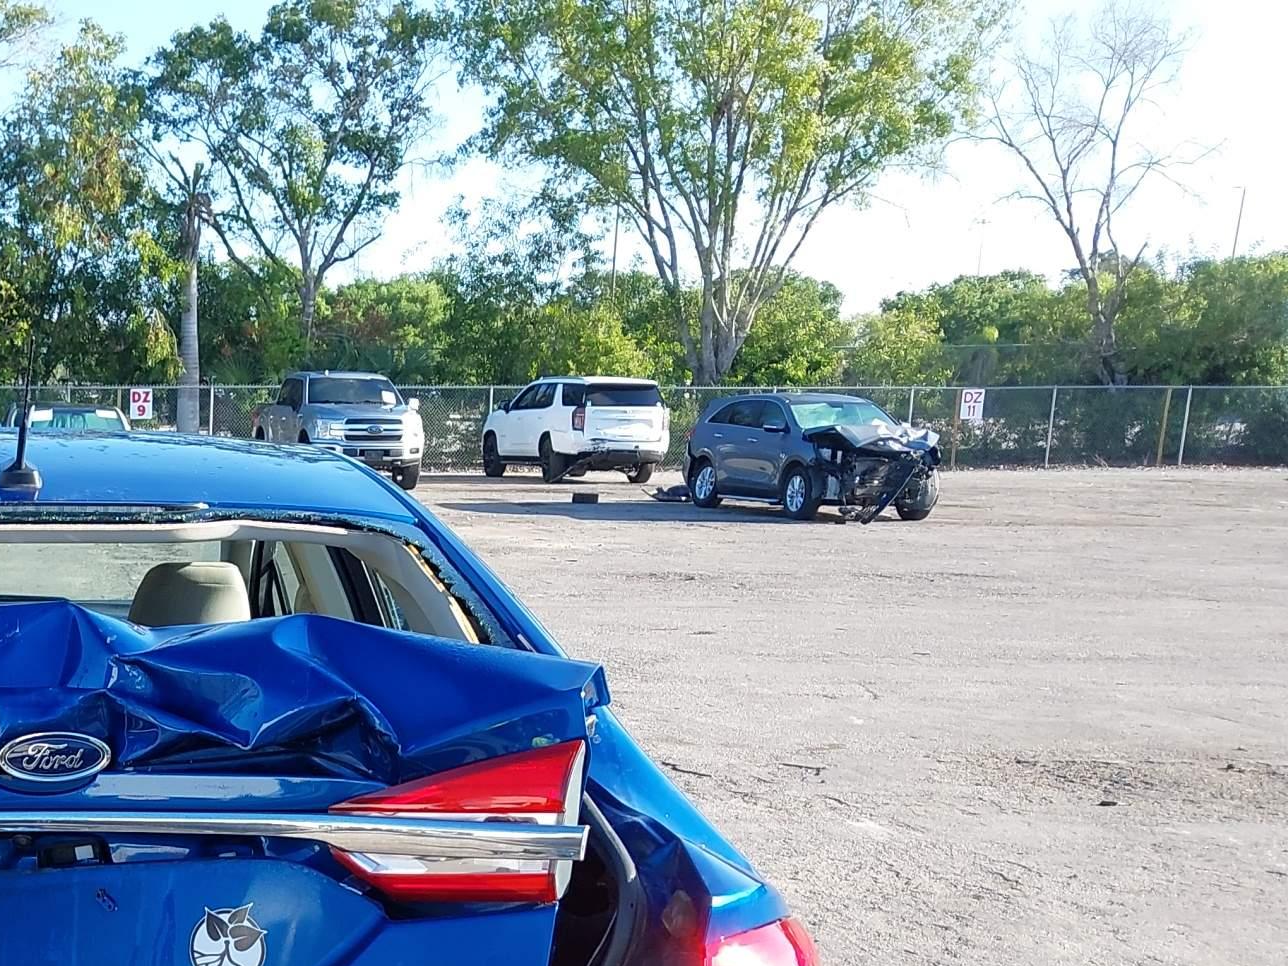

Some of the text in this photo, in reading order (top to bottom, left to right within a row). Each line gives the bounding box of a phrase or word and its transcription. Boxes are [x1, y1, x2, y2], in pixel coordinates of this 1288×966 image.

[132, 391, 150, 403] DZ
[964, 391, 983, 403] DZ
[137, 404, 146, 417] 9
[967, 404, 976, 417] 11
[22, 743, 83, 770] Ford
